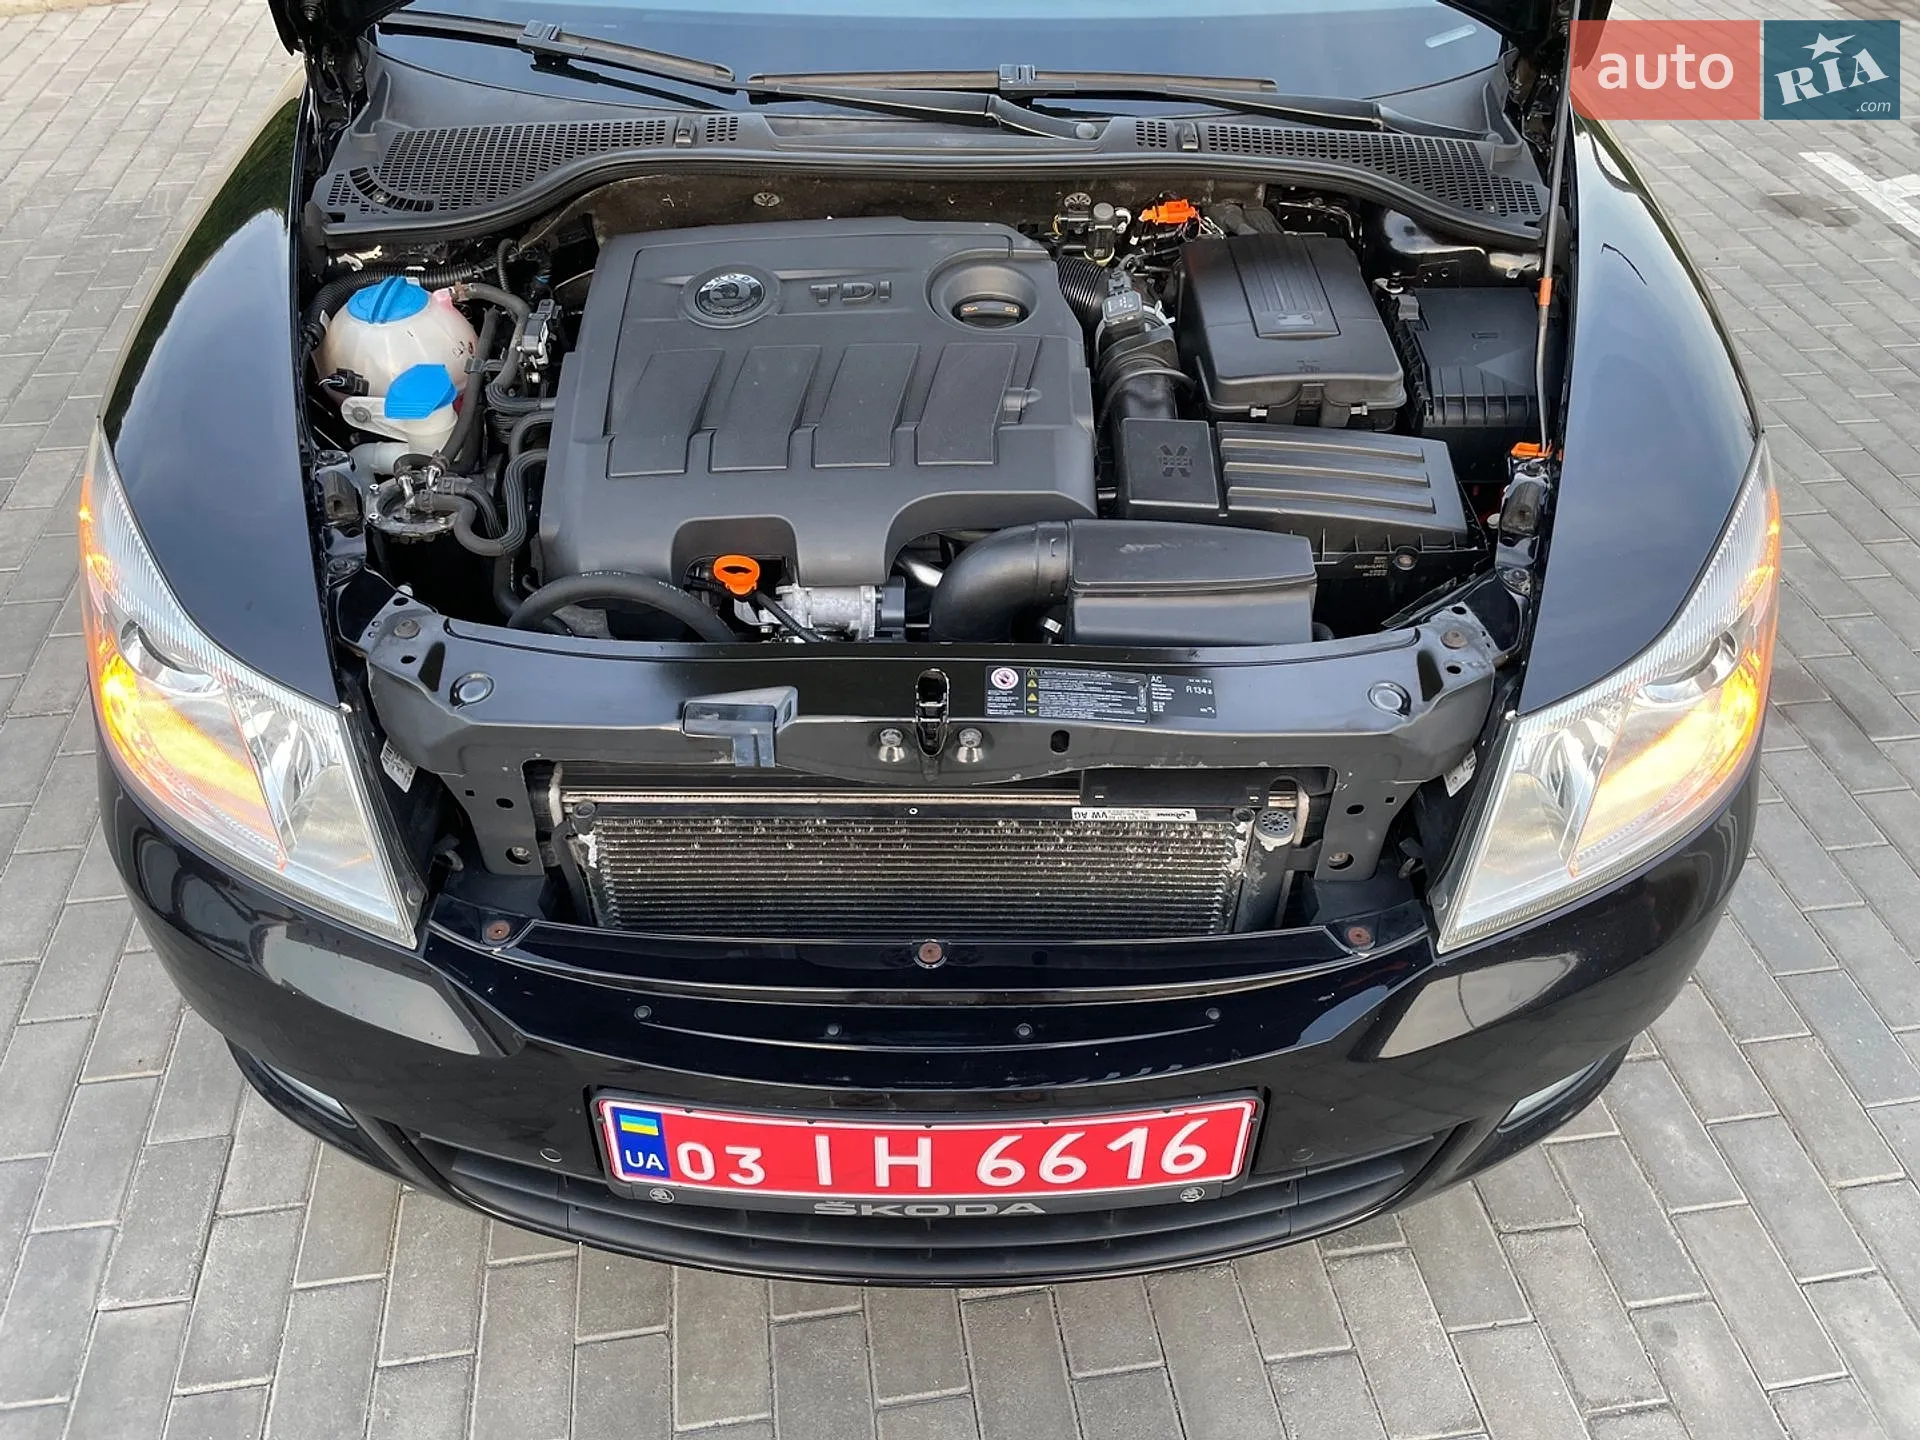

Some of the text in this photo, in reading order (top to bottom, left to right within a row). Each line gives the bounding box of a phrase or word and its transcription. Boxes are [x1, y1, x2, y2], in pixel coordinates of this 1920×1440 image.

[810, 281, 892, 305] TDI
[625, 1149, 665, 1171] UA
[676, 1142, 766, 1186] 03
[976, 1118, 1209, 1187] 6616
[814, 1200, 1046, 1216] ŠKODA
